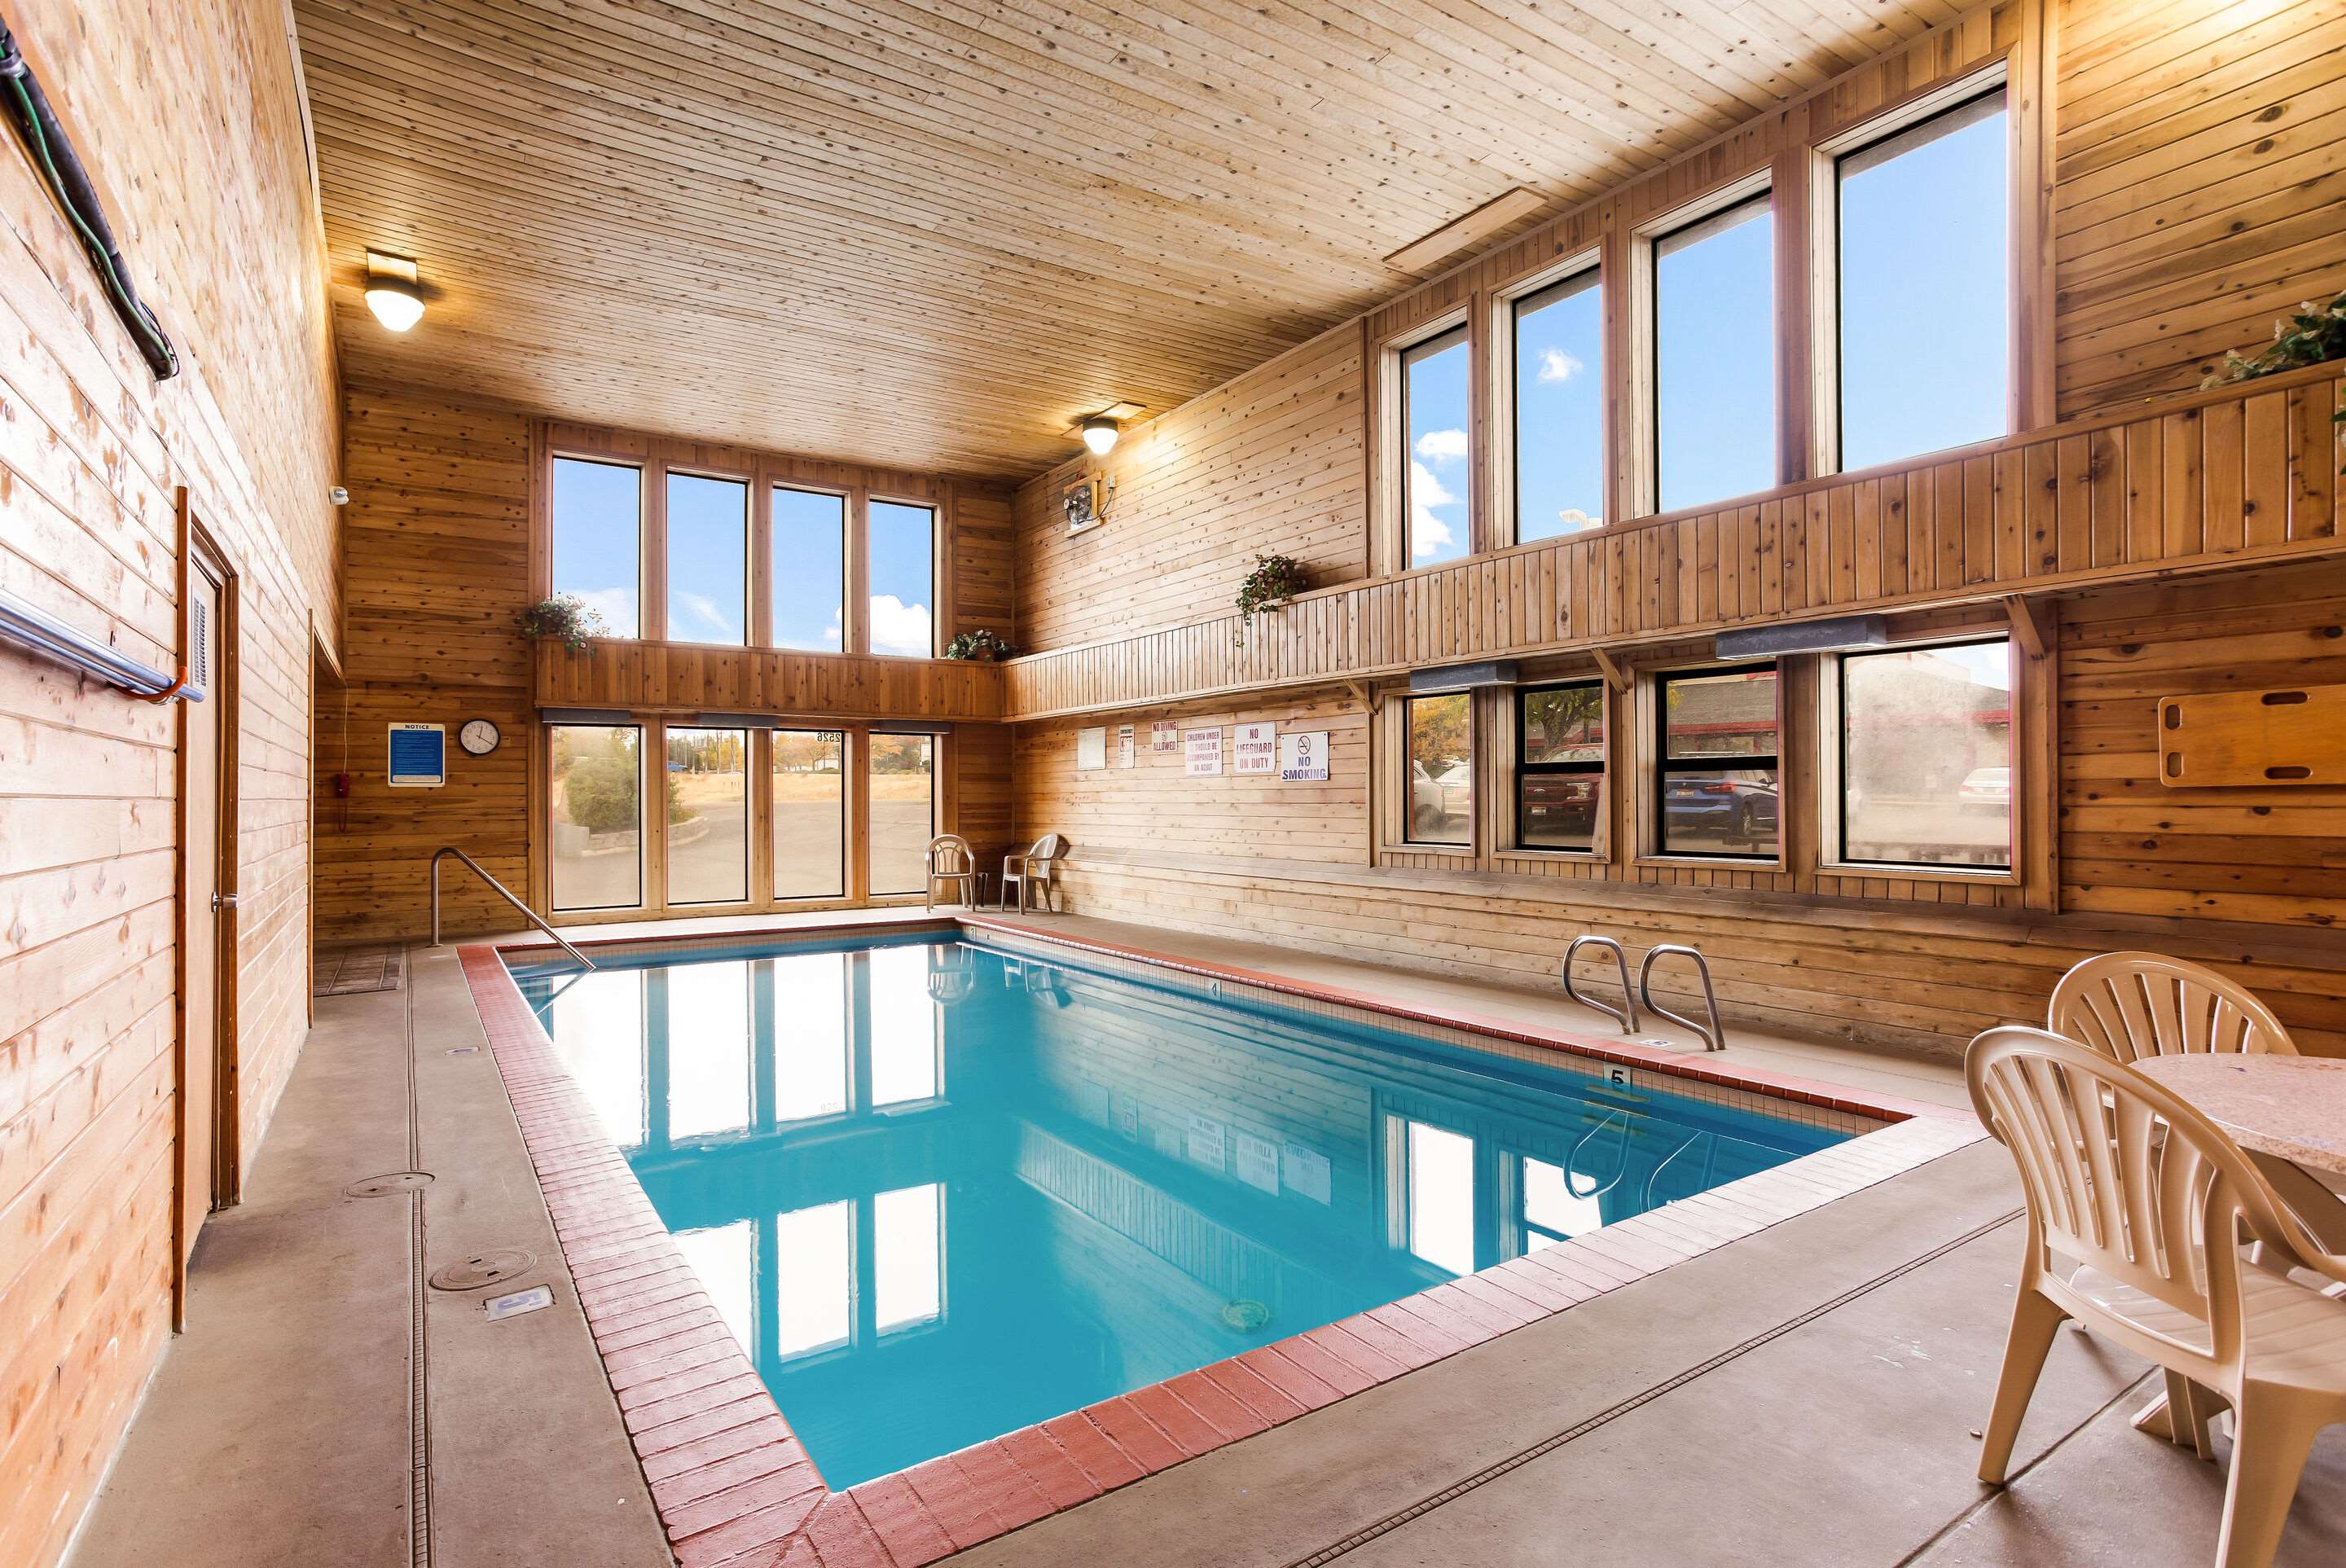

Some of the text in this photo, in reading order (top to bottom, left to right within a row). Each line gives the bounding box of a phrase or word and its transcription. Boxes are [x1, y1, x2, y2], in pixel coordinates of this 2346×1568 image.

[1153, 722, 1176, 731] NO DIVING
[1188, 731, 1219, 741] CHILDREN UNDER
[1250, 728, 1259, 739] NO
[1153, 741, 1175, 751] ALLOWED
[1196, 743, 1210, 751] SHOULD
[1237, 742, 1272, 754] LIFEGUARD
[1201, 763, 1212, 771] ADULT
[1240, 758, 1268, 769] ON DUTY
[1298, 757, 1311, 767] NO
[1282, 768, 1326, 780] SMOKING
[1611, 1069, 1623, 1084] 5
